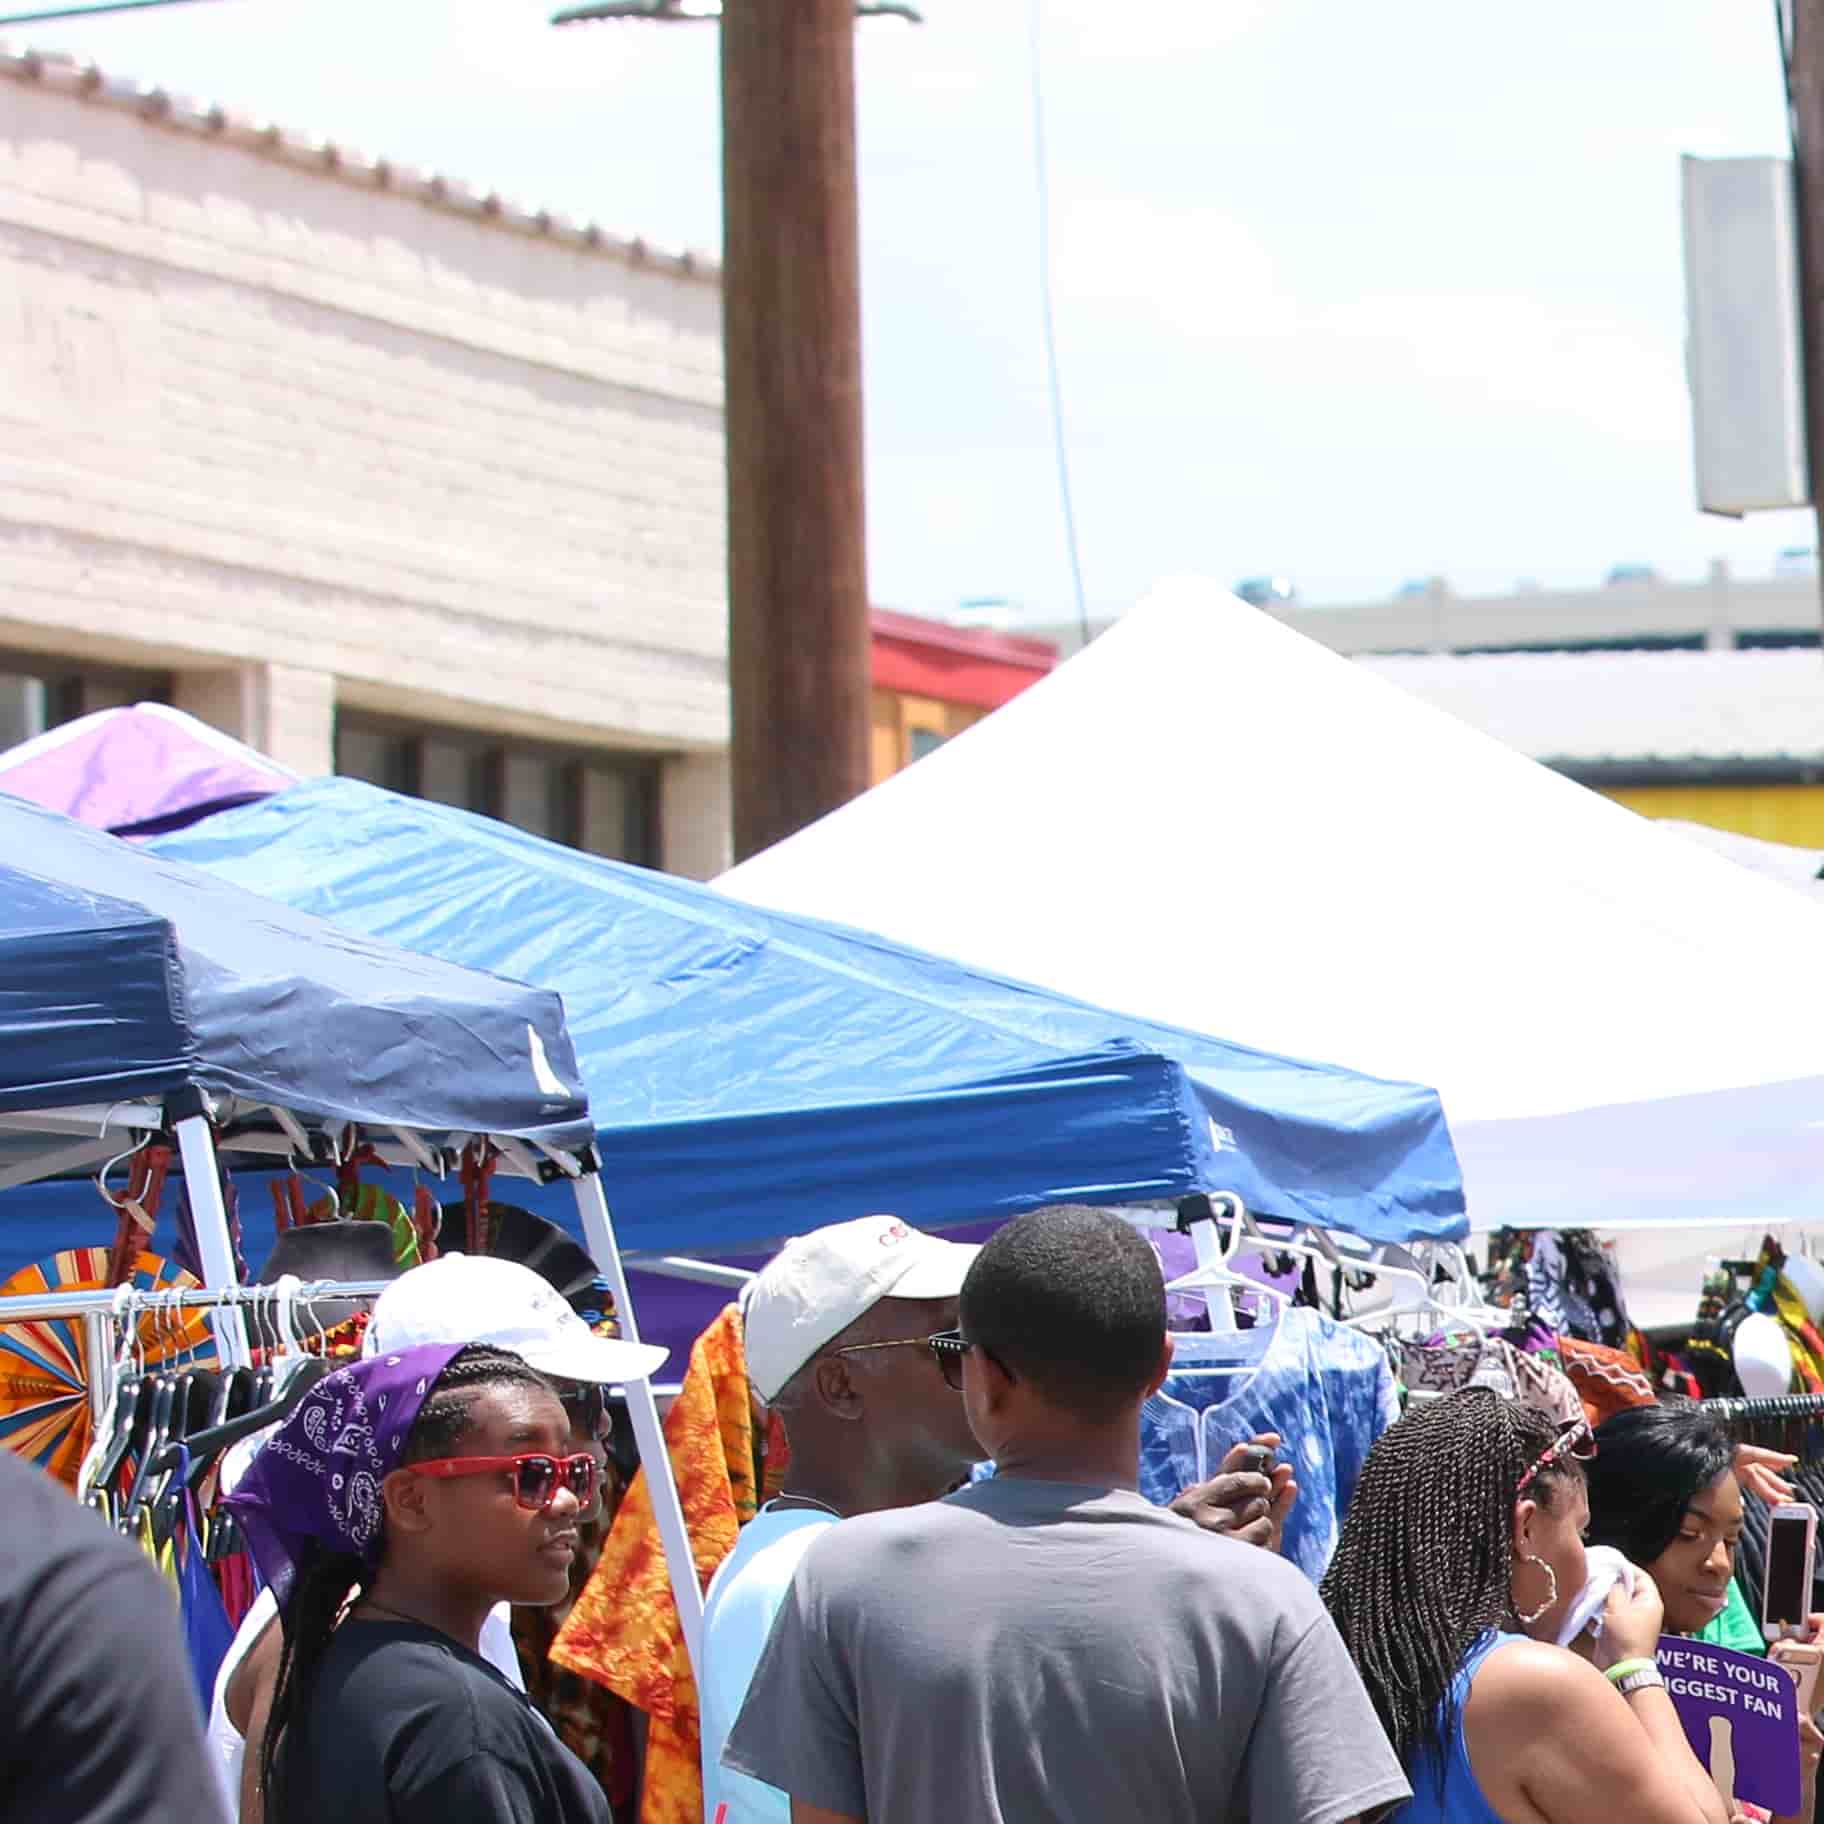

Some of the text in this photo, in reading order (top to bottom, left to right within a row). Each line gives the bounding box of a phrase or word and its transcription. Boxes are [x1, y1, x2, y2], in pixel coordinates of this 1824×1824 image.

[1723, 1661, 1781, 1694] YOUR
[1664, 1677, 1783, 1720] IGGEST FAN
